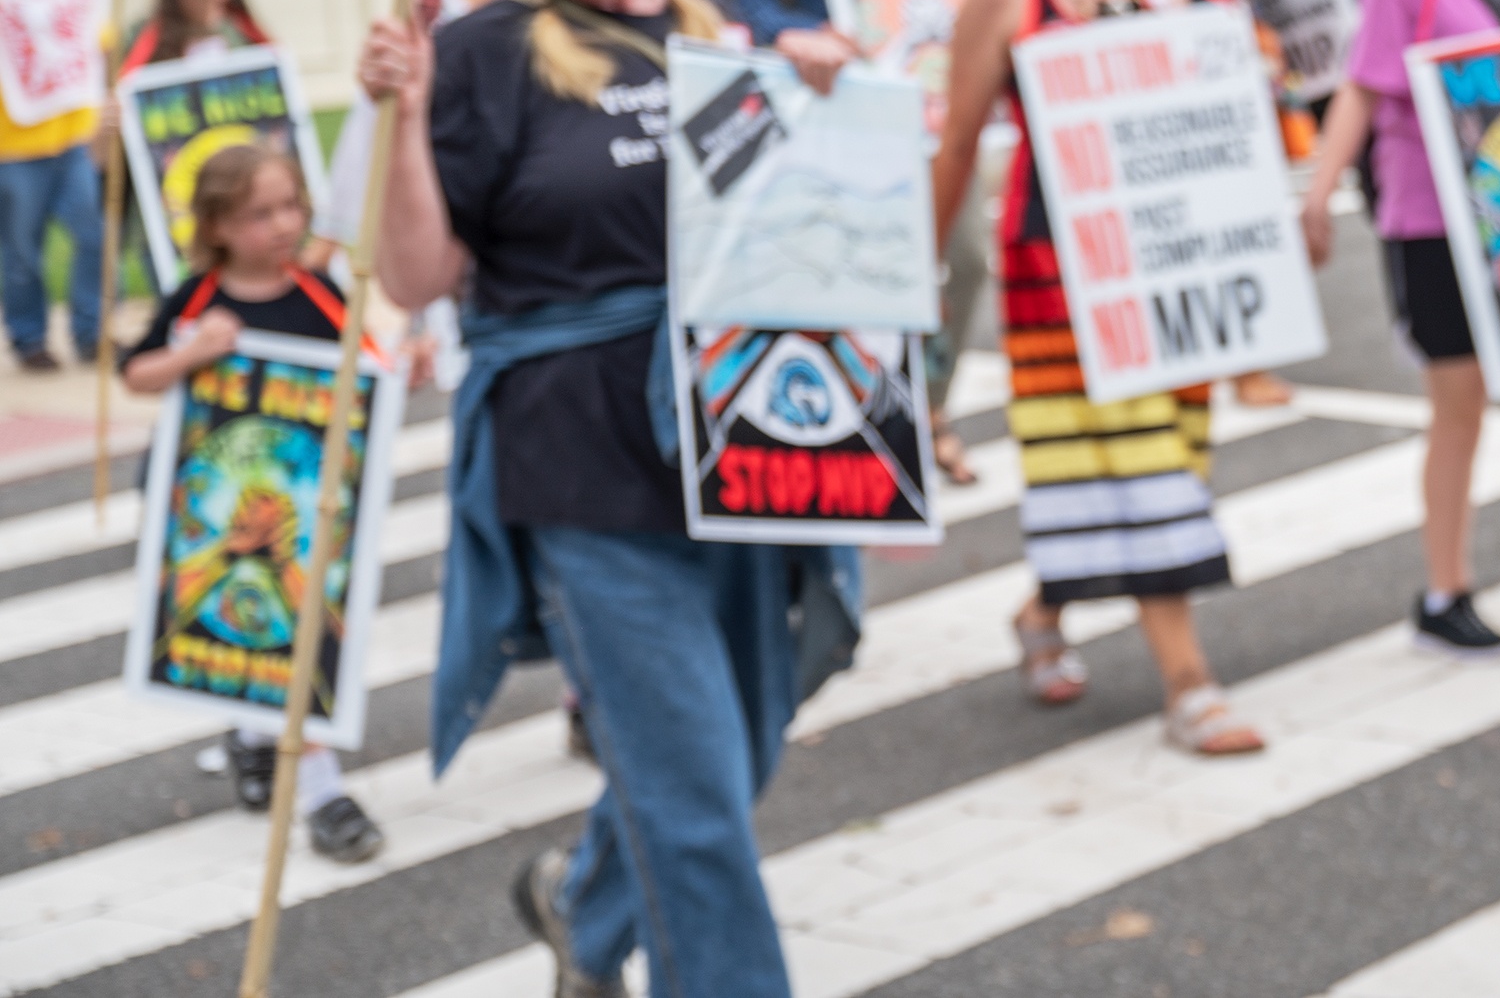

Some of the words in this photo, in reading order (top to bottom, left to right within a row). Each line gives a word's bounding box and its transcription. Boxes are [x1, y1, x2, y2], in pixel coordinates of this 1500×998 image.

[1052, 119, 1116, 198] NO
[1070, 206, 1134, 285] NO
[1091, 294, 1152, 376] NO
[1151, 273, 1265, 365] MVP
[717, 443, 814, 515] STOP
[817, 450, 899, 517] MVP
